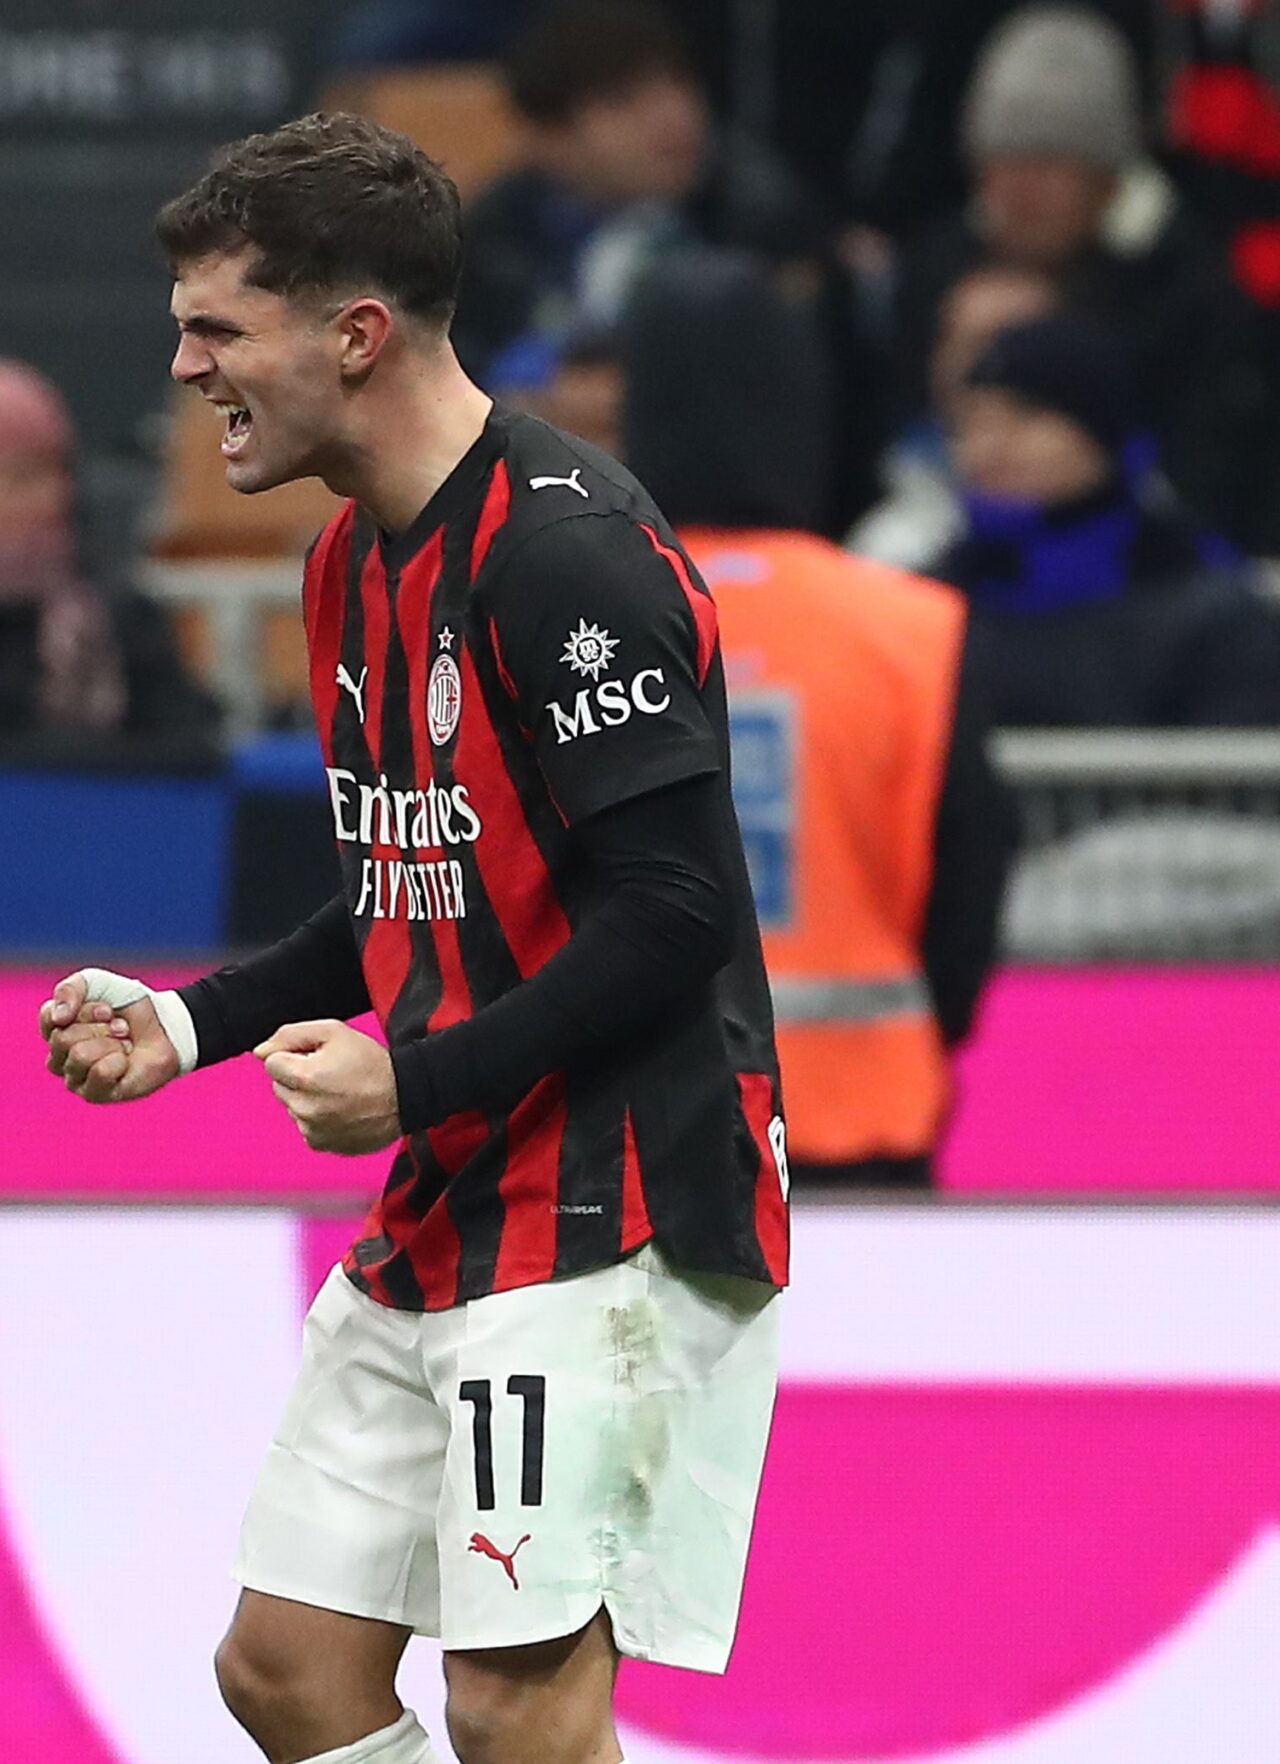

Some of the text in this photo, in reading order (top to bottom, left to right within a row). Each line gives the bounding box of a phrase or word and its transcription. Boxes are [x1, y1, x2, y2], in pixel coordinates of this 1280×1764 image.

[545, 668, 670, 744] MSC
[354, 859, 402, 919] FLY
[459, 1374, 546, 1511] 11
